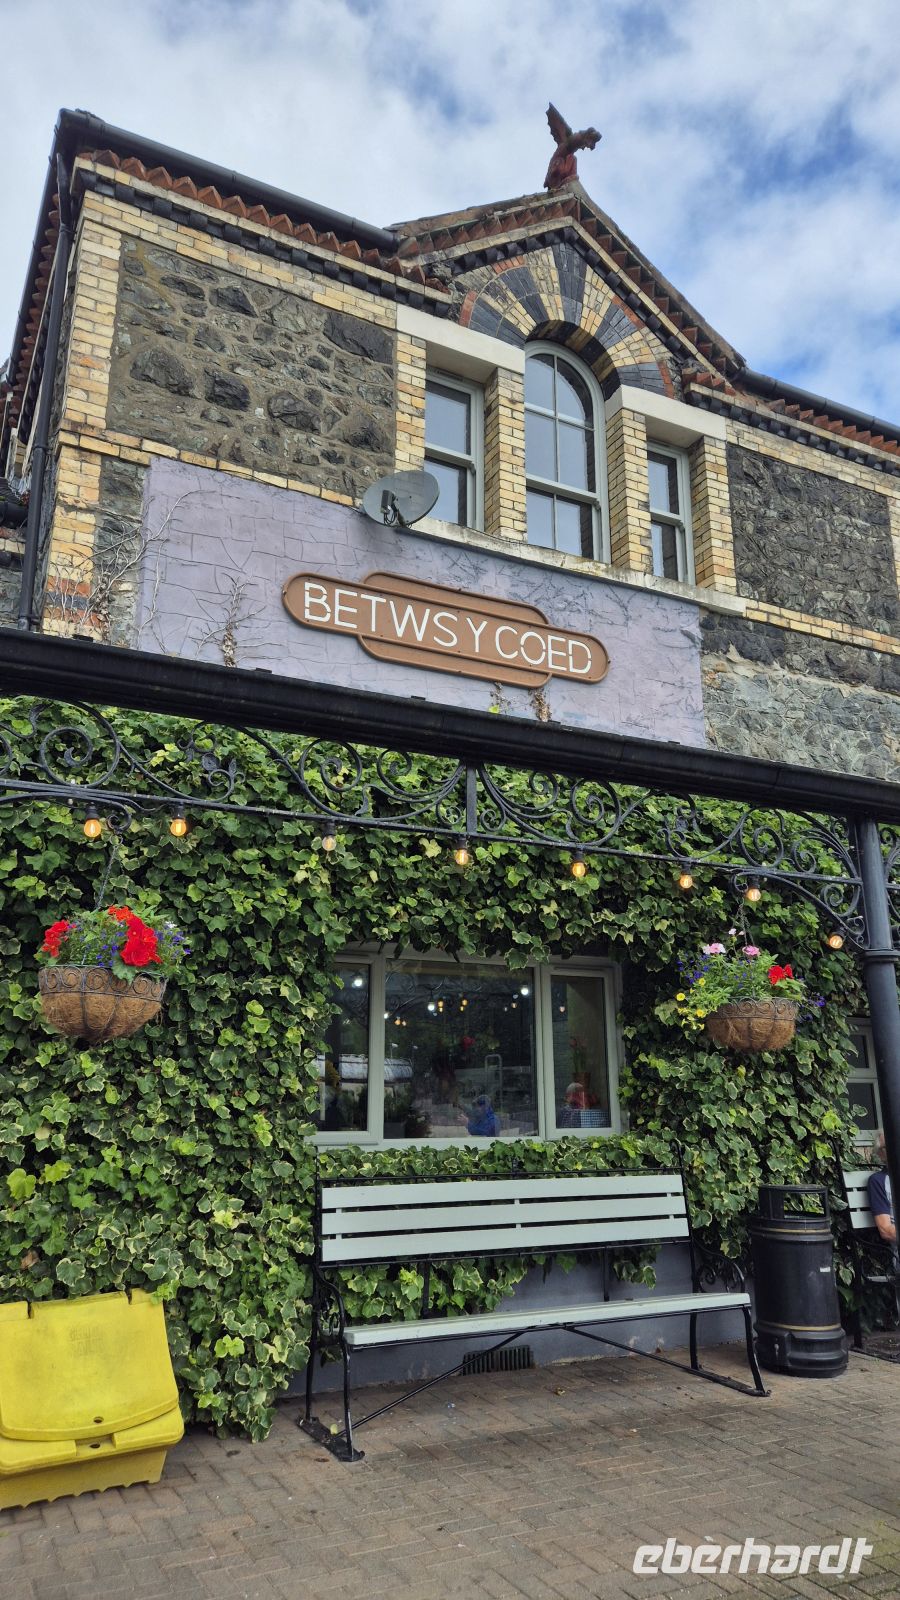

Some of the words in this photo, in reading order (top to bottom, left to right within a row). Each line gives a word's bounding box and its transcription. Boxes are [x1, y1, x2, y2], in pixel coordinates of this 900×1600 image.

[304, 582, 458, 647] BETWS
[466, 617, 488, 653] Y
[495, 626, 592, 673] COED
